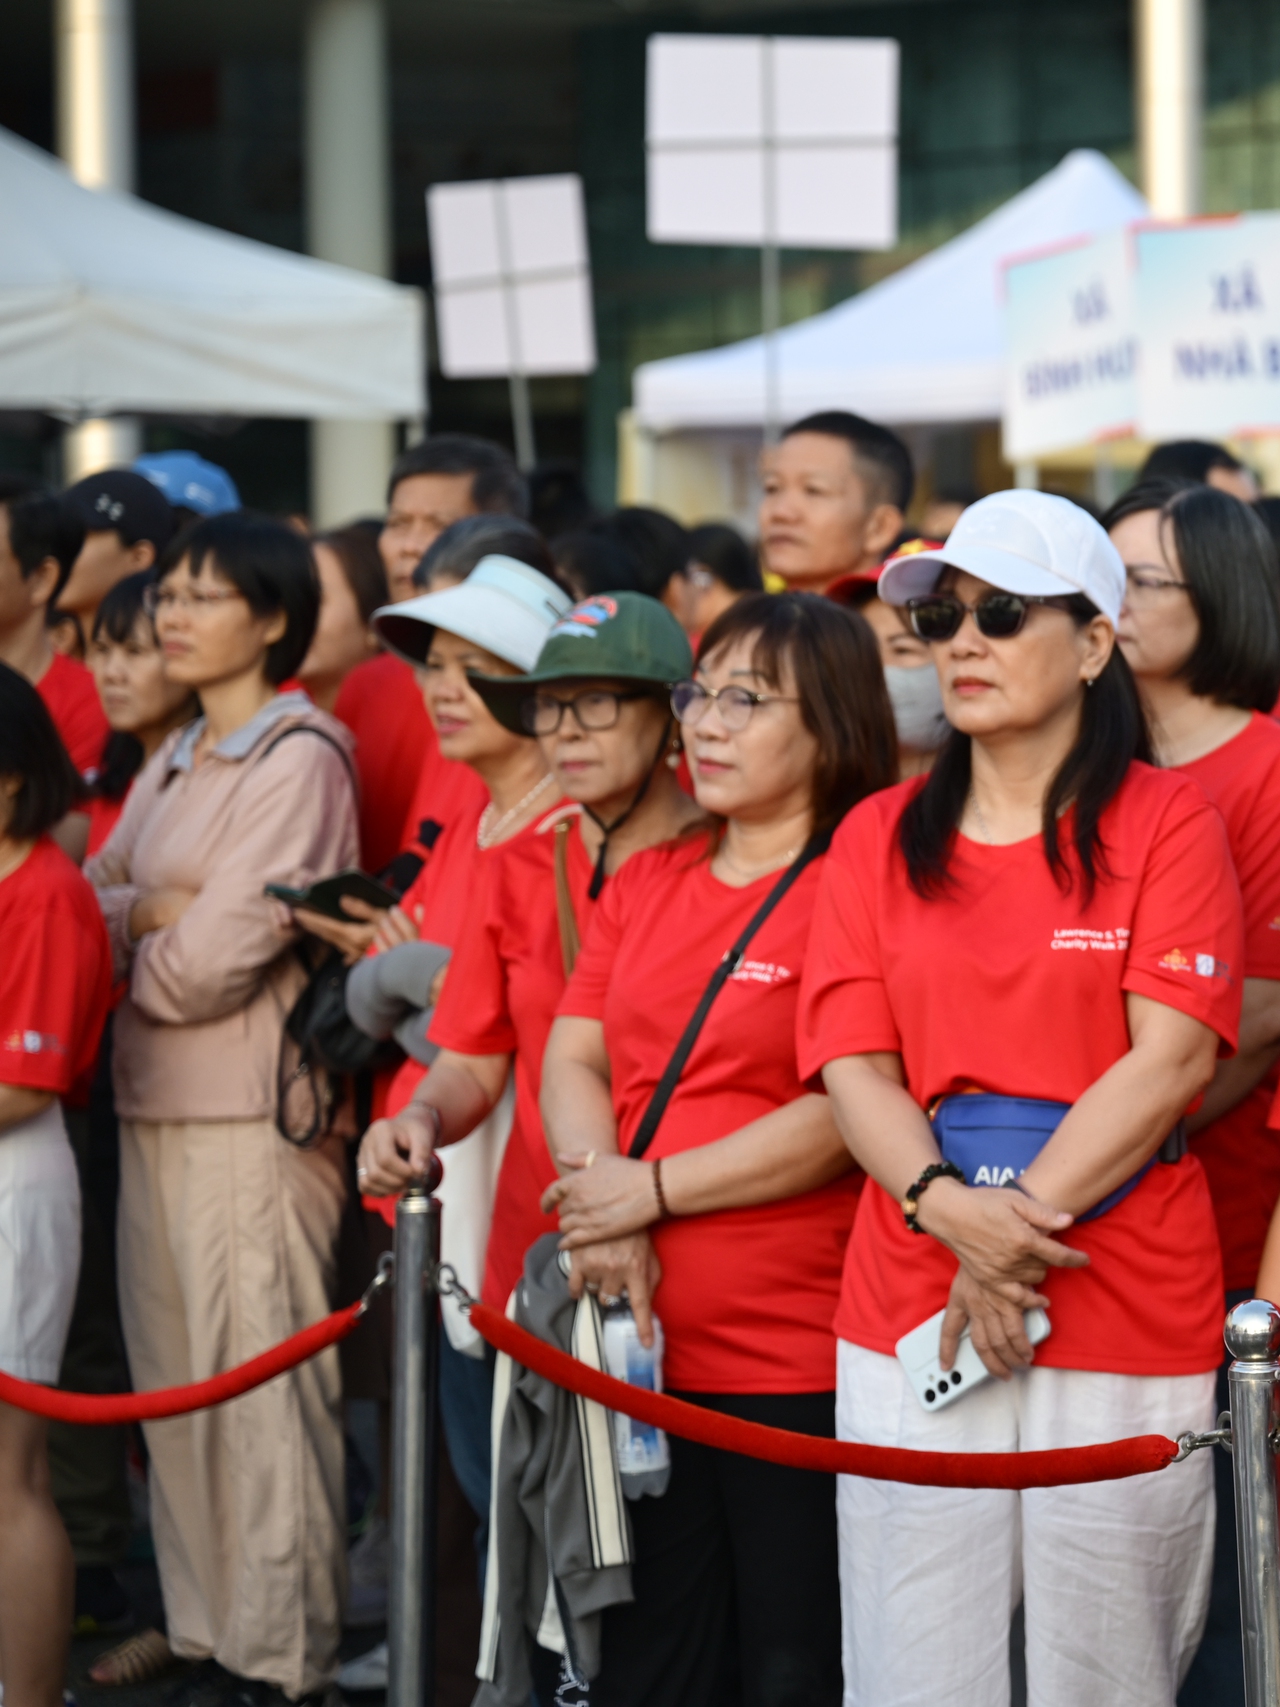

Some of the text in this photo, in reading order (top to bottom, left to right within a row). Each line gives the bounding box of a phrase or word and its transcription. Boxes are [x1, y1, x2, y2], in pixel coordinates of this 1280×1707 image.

[1053, 928, 1103, 940] Lawrence
[1050, 939, 1088, 951] Charity
[973, 1165, 1015, 1187] AIA
